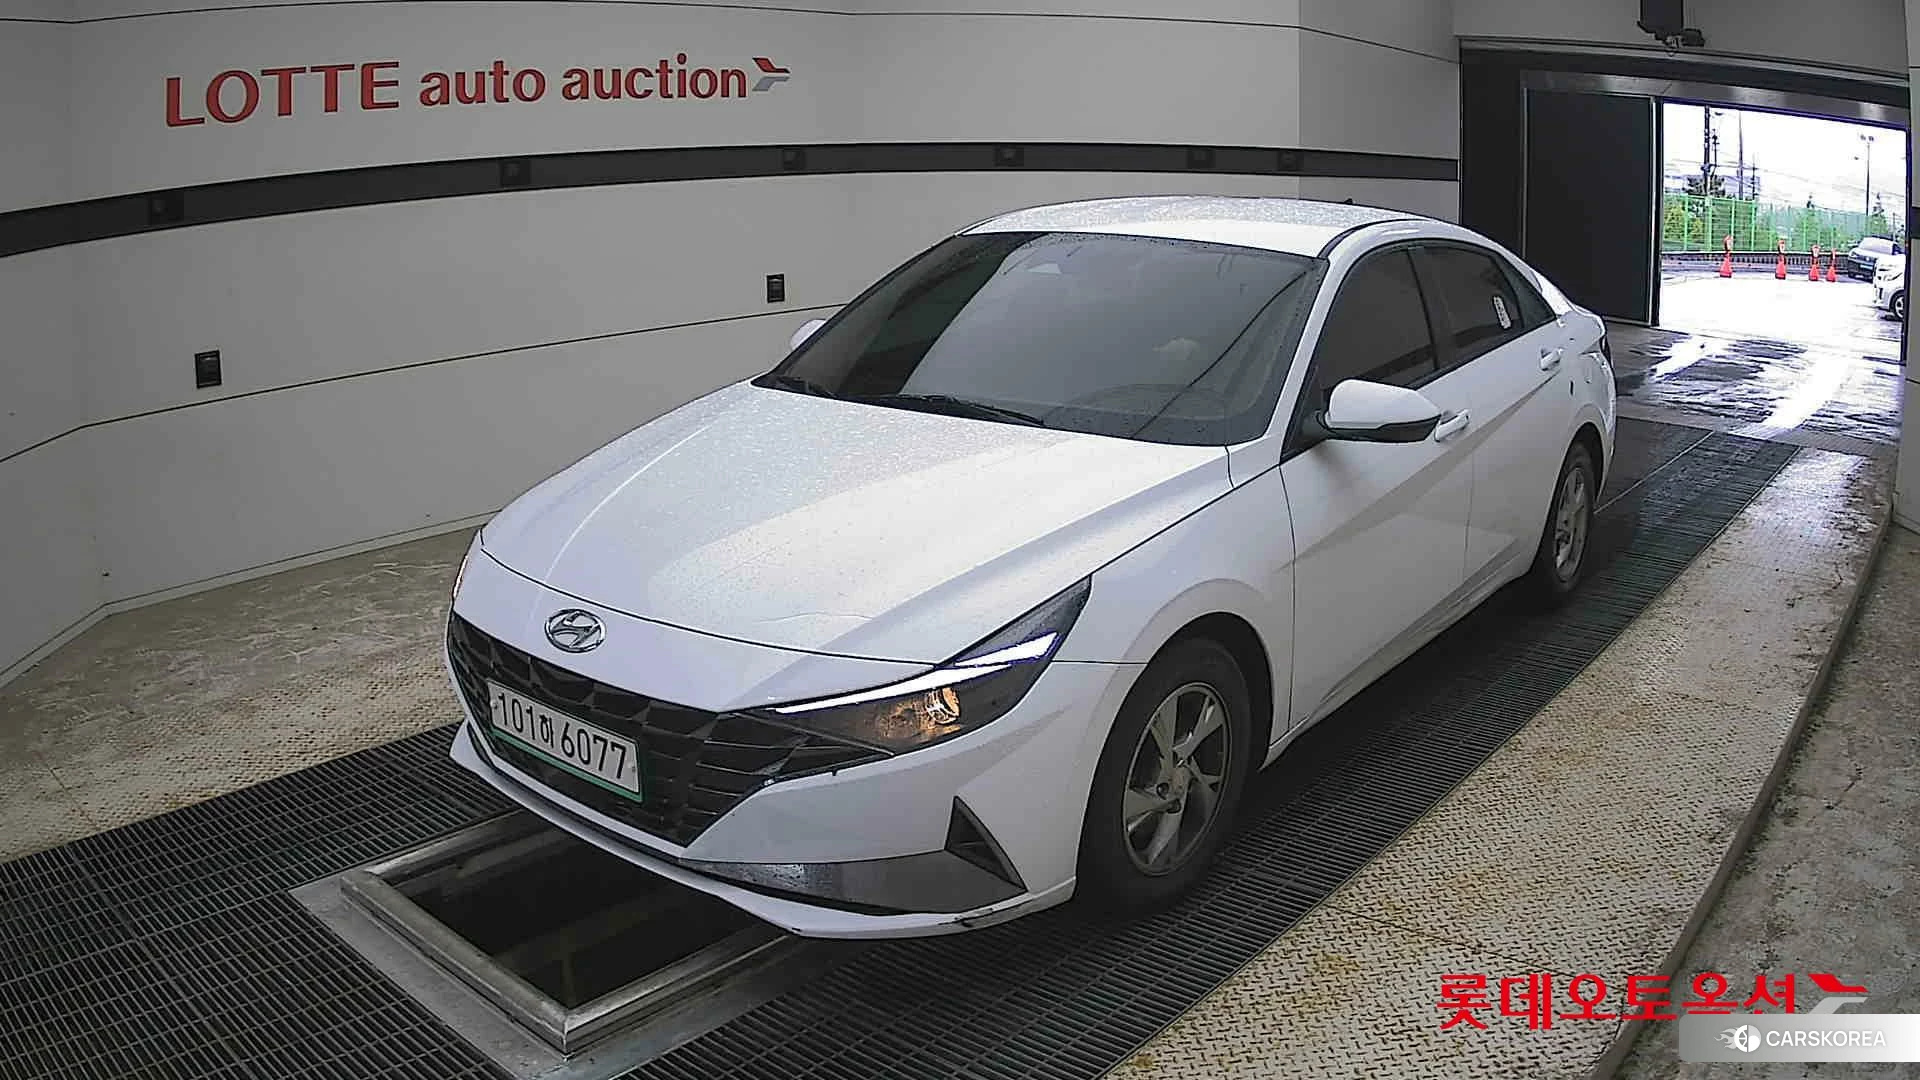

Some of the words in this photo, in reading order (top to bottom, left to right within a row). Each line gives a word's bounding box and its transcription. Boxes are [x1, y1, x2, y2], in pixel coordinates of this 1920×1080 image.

[165, 61, 400, 127] LOTTE
[419, 59, 546, 107] auto
[562, 52, 748, 100] auction
[561, 721, 626, 780] 6077
